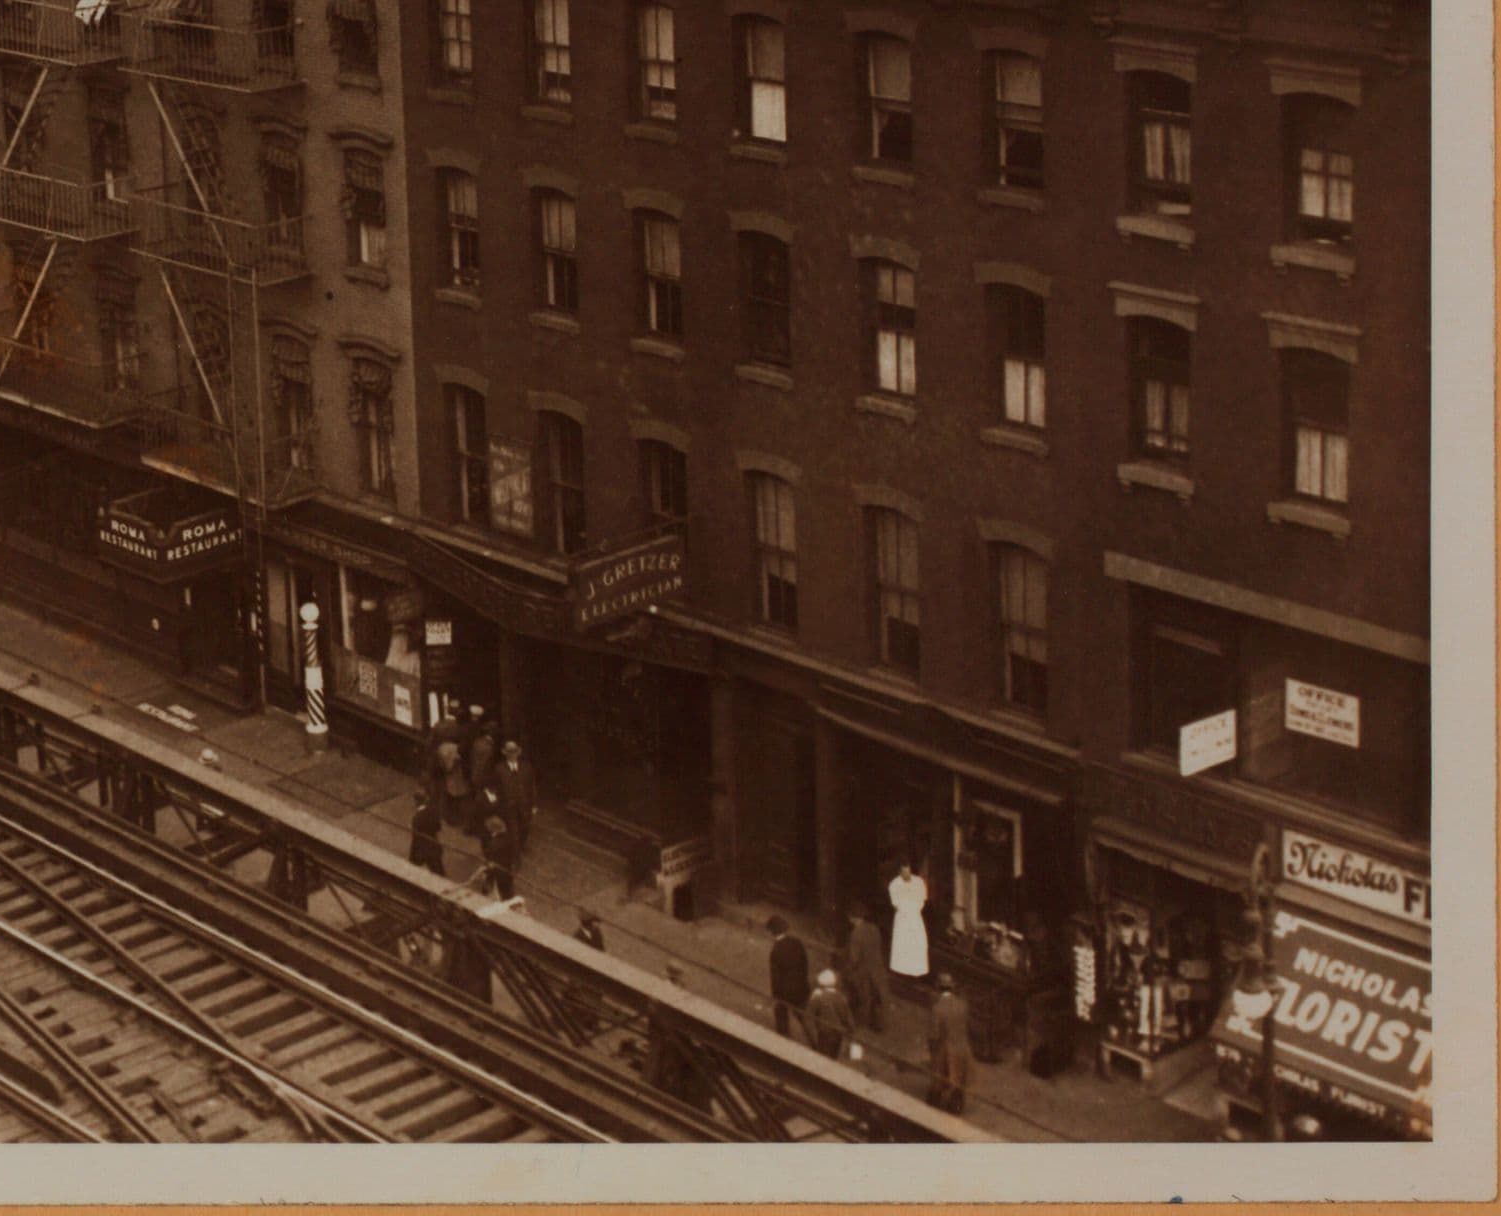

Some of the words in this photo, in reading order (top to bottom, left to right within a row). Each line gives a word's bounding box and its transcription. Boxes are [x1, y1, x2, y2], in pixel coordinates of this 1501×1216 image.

[100, 529, 157, 561] RESTAURANT
[111, 519, 146, 542] ROMA
[166, 528, 242, 561] RESTAURANT
[182, 519, 227, 542] ROMA
[1287, 841, 1399, 894] Nicholas
[1293, 947, 1432, 1018] NICHOLAS
